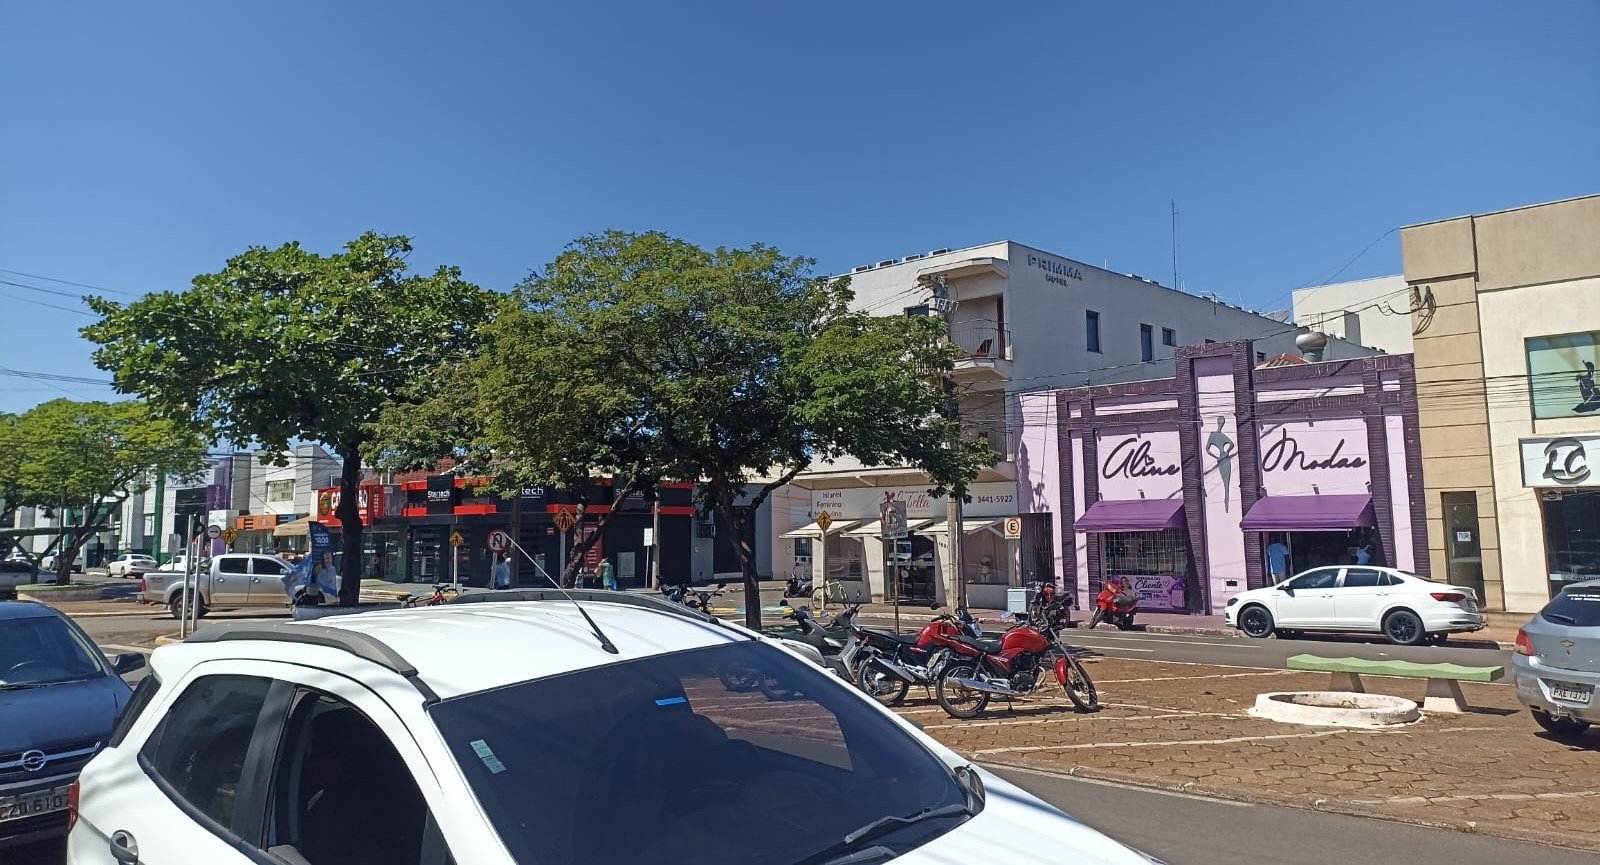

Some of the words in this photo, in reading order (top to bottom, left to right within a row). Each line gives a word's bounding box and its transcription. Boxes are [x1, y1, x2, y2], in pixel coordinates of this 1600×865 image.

[1028, 254, 1082, 281] PRIMMA
[1102, 437, 1180, 479] Aline
[1262, 427, 1366, 472] Modas
[1543, 443, 1588, 481] LC
[977, 496, 1013, 504] 3441-5922
[1010, 522, 1016, 531] E
